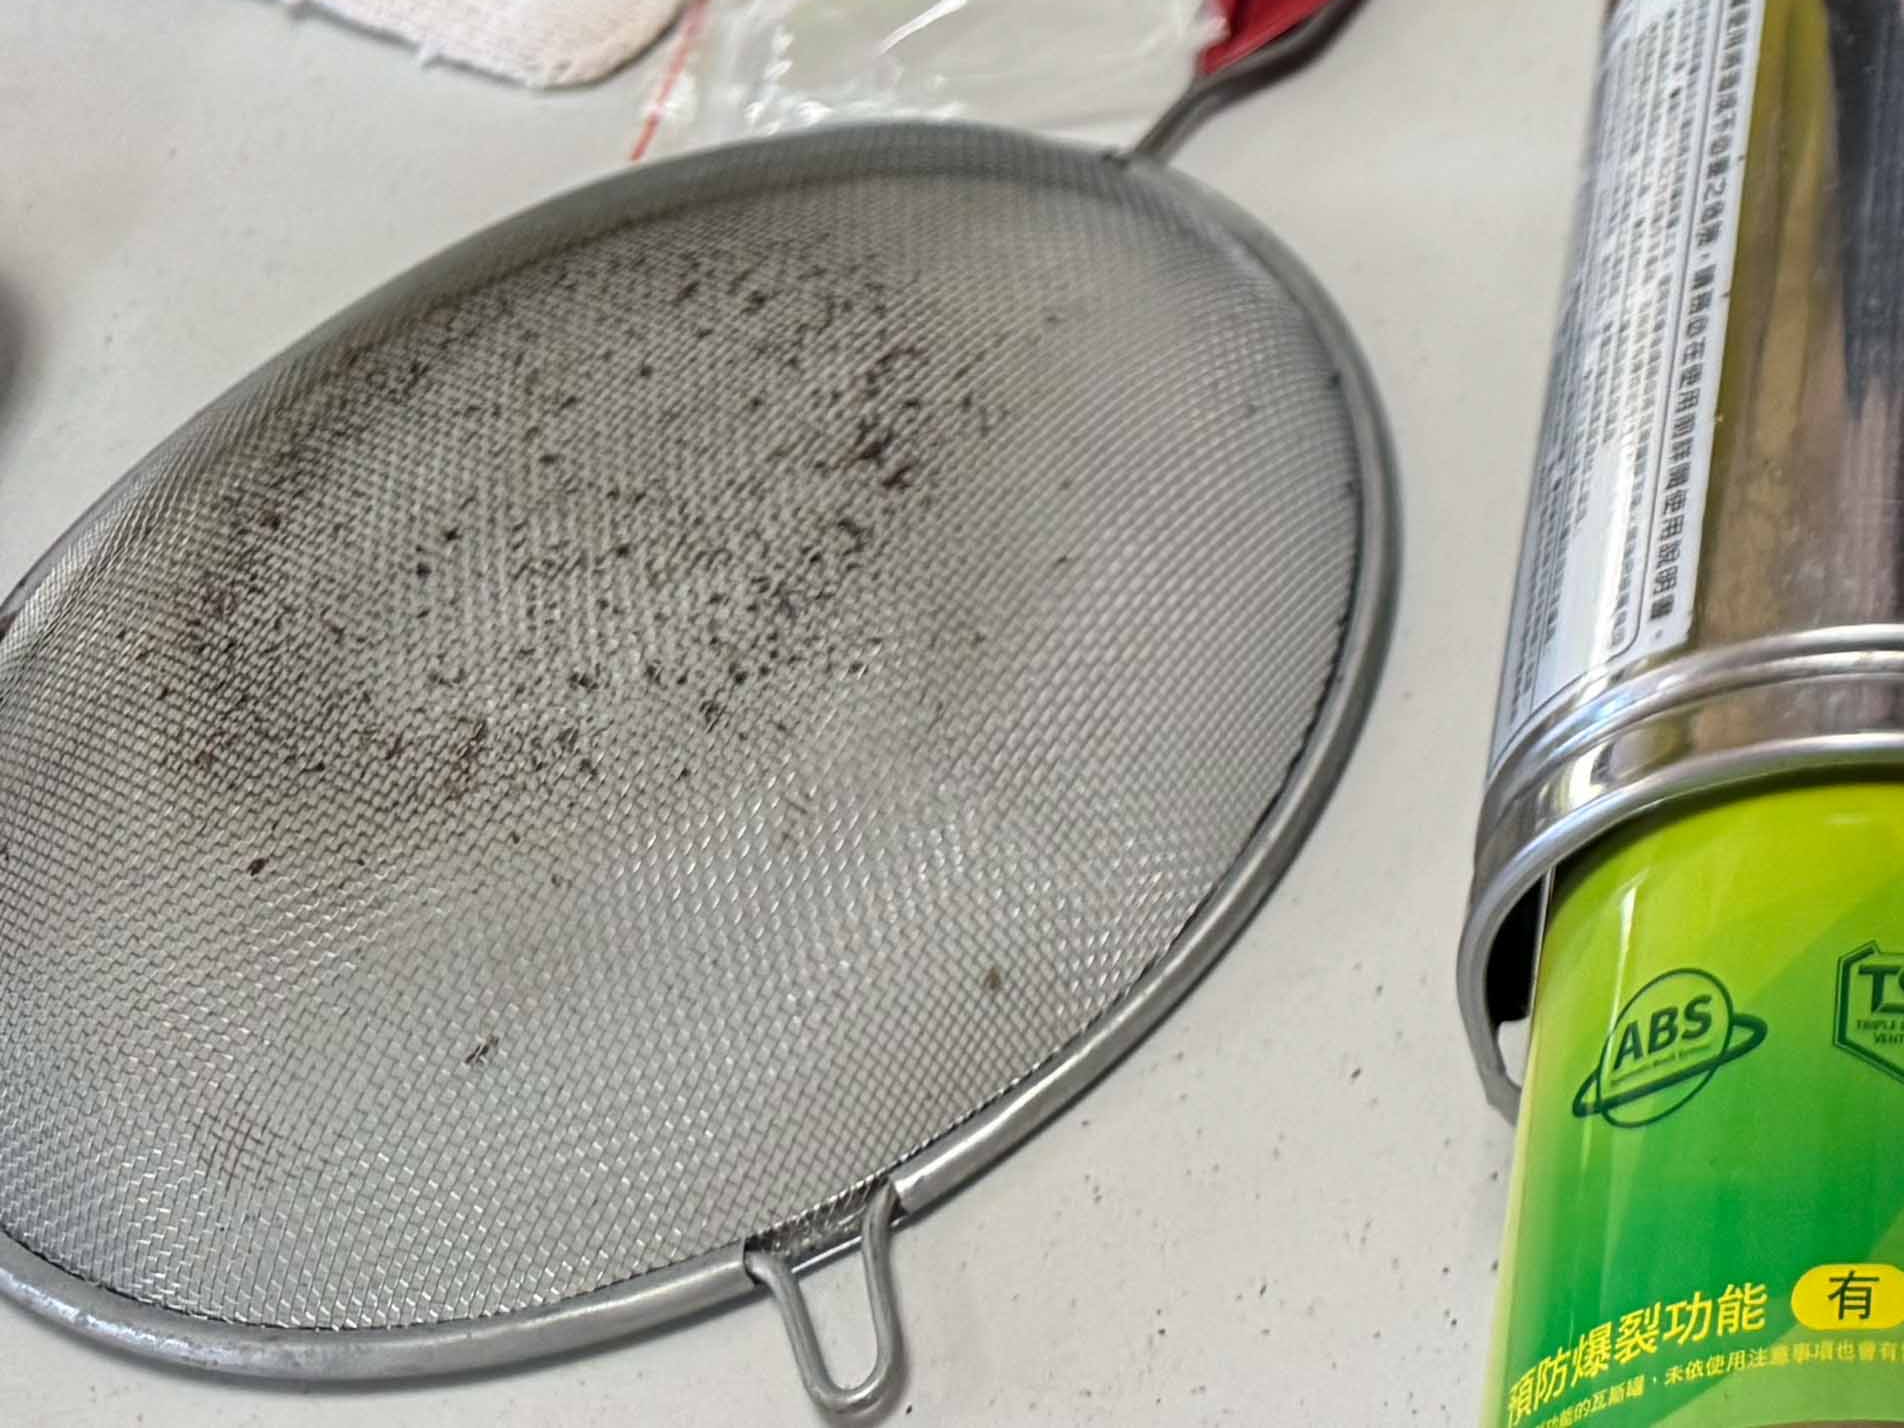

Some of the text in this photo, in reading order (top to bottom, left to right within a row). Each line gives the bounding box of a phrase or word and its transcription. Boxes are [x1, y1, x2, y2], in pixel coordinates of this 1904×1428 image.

[1613, 993, 1714, 1071] ABS
[1508, 1282, 1769, 1427] 預防爆裂功能
[1828, 1270, 1880, 1320] 有
